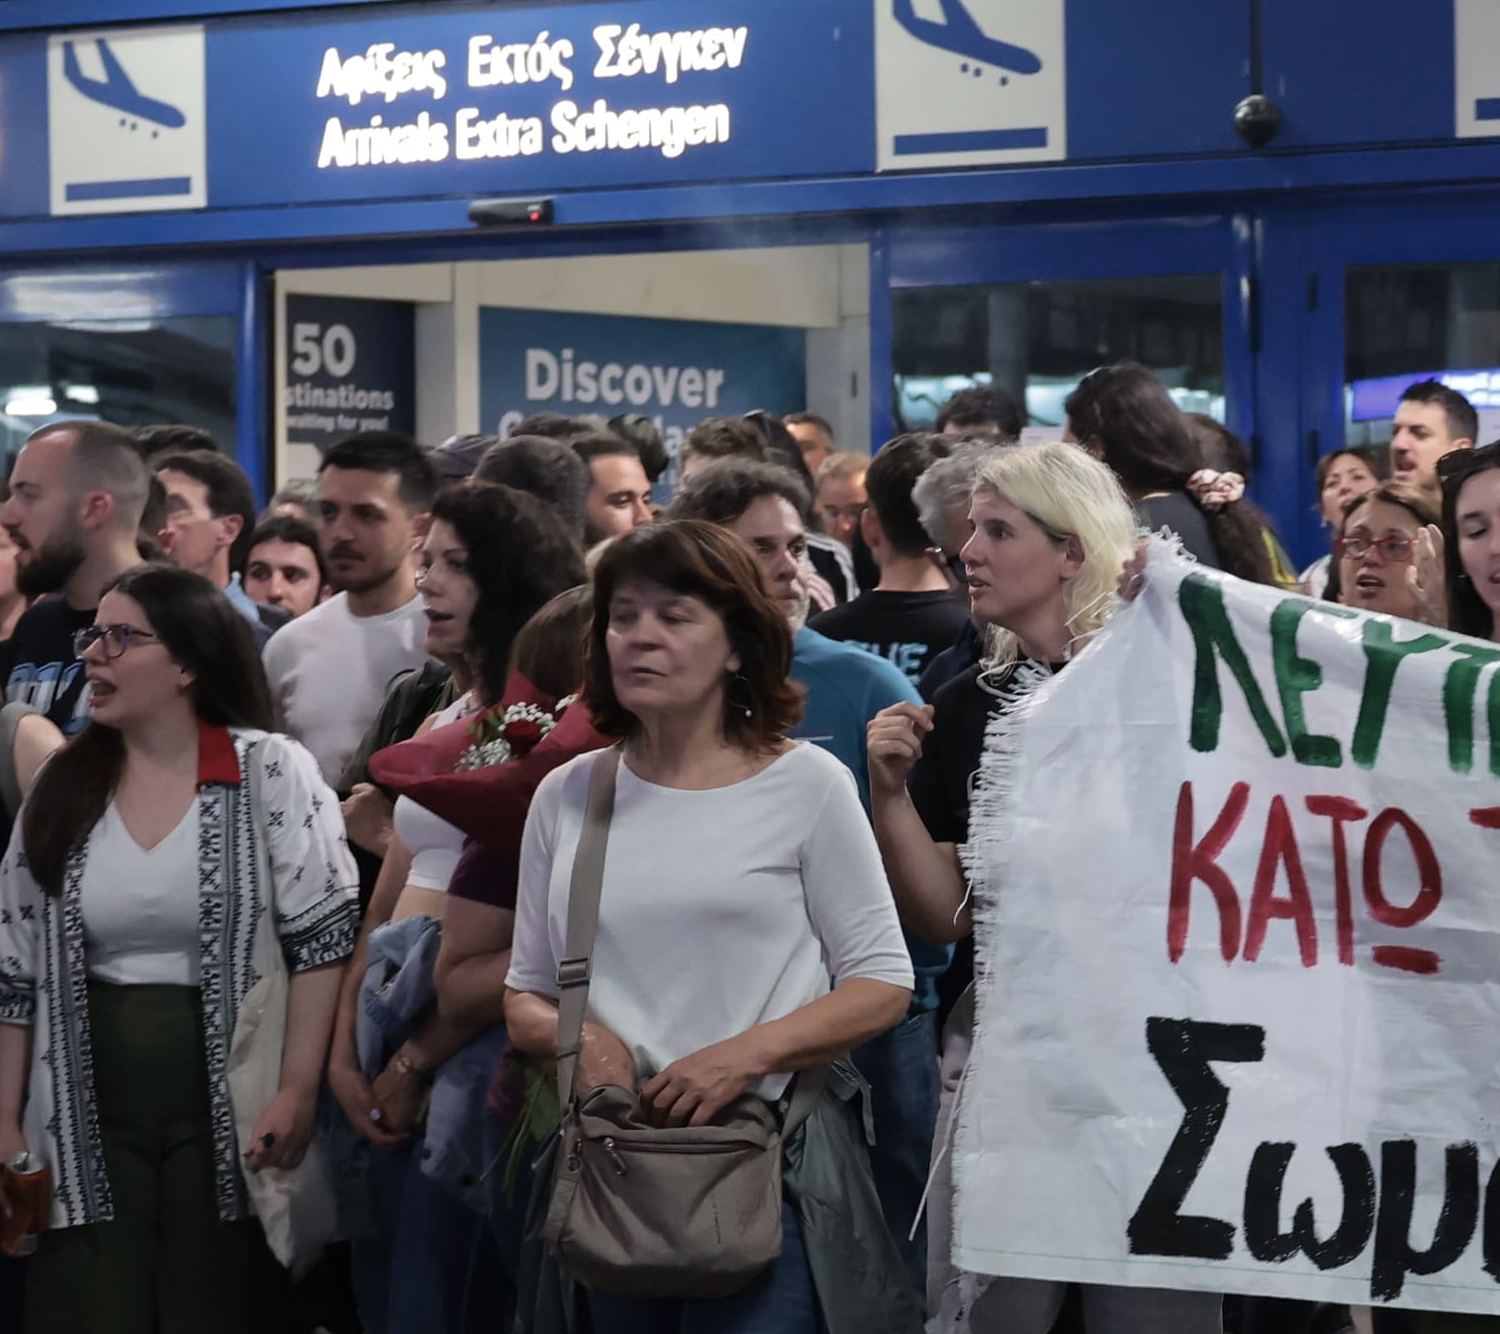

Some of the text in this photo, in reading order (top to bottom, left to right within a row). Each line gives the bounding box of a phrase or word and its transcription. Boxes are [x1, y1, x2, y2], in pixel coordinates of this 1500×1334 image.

[315, 22, 749, 107] Αφίξεις Εκτός Σένγκεν
[316, 97, 731, 170] Arrivals Extra Schengen
[286, 381, 395, 411] stinations
[525, 347, 725, 409] Discover
[1166, 780, 1443, 976] ΚΑΤΩ
